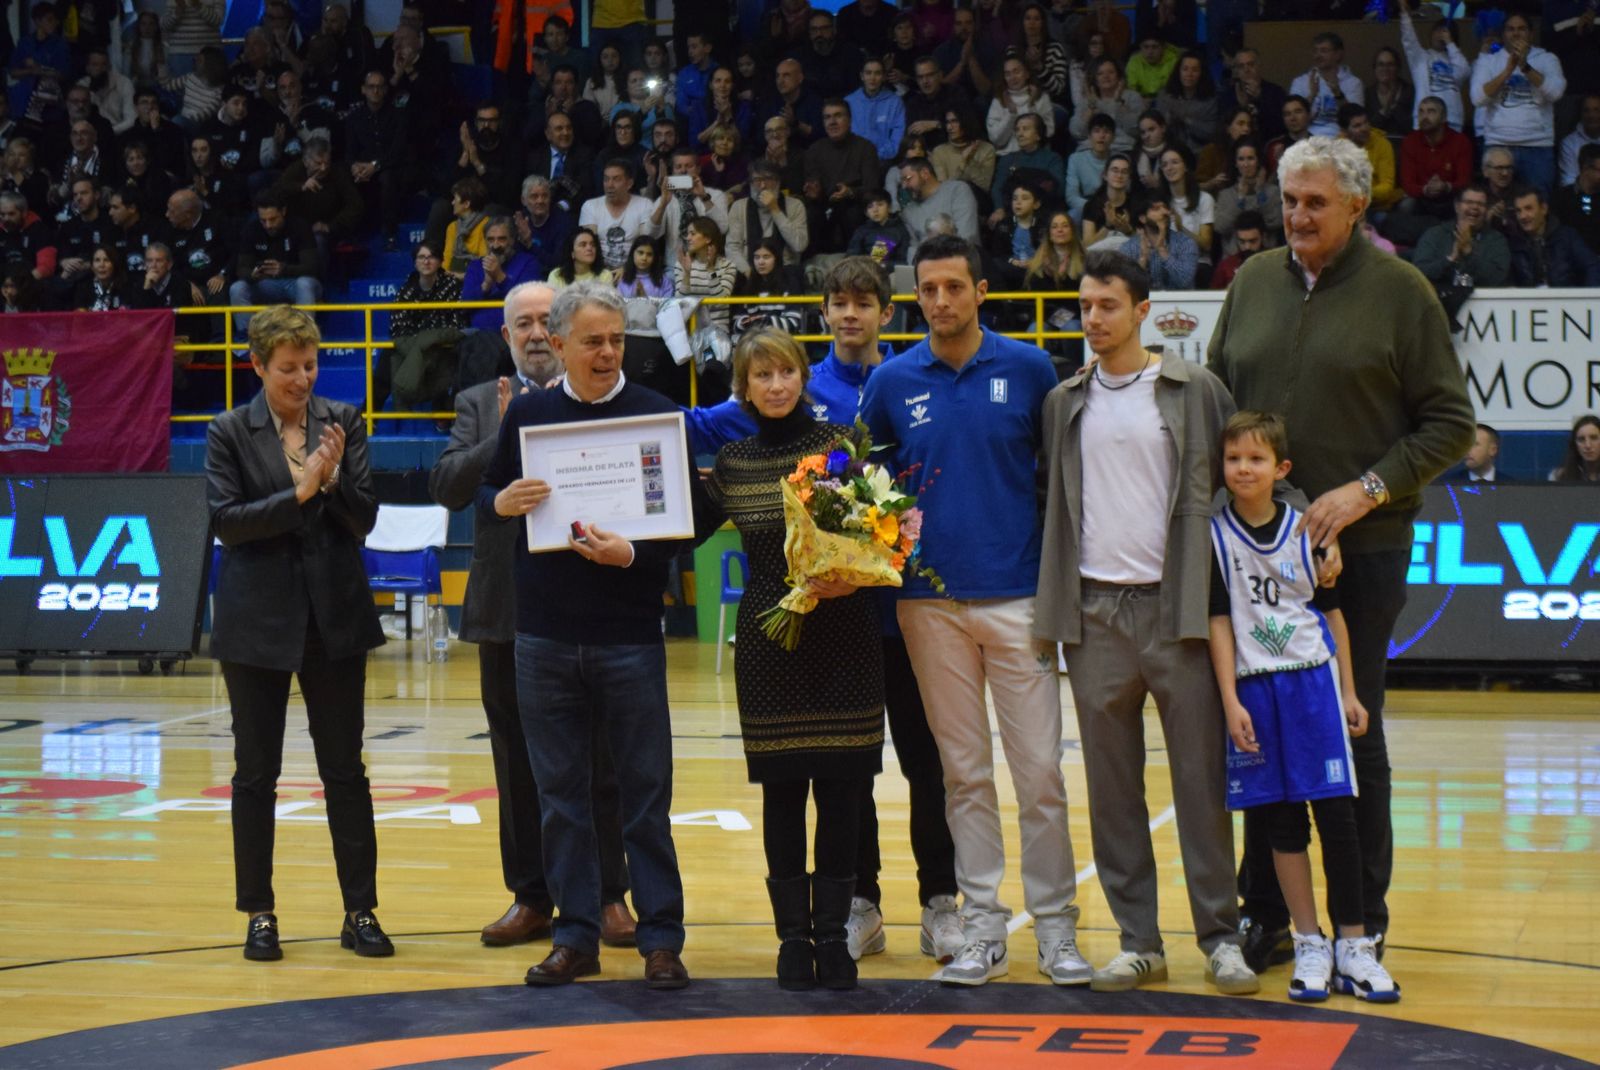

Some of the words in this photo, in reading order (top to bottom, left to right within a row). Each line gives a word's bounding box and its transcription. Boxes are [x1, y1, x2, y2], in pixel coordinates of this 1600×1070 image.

[595, 463, 607, 472] DE
[608, 461, 635, 470] PLATA
[38, 583, 160, 611] 2024
[1248, 576, 1280, 607] 30
[926, 1025, 1261, 1057] FEB
